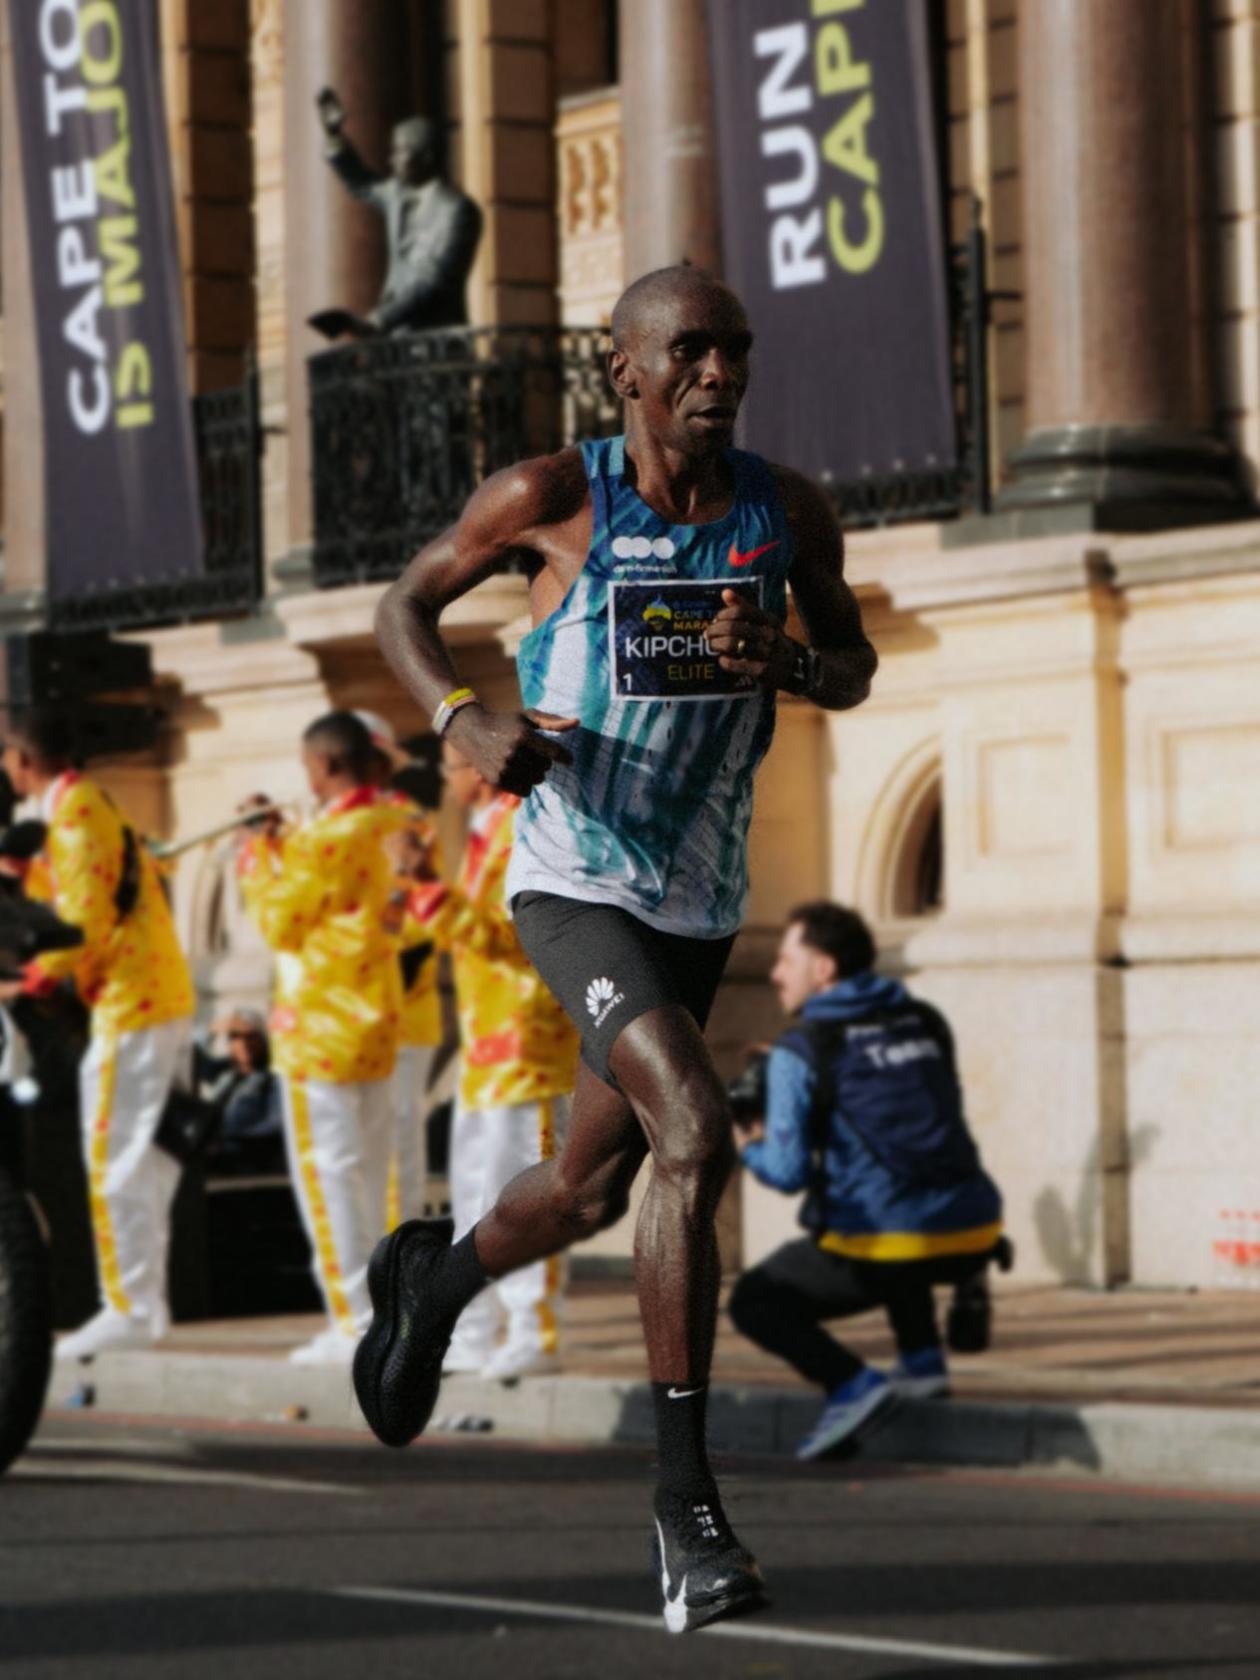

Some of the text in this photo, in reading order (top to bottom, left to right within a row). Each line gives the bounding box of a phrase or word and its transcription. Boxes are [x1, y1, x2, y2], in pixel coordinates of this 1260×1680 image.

[754, 21, 826, 290] RUN
[51, 158, 111, 435] CAPE
[115, 341, 154, 430] IS
[623, 673, 633, 692] 1
[667, 664, 715, 681] ELITE
